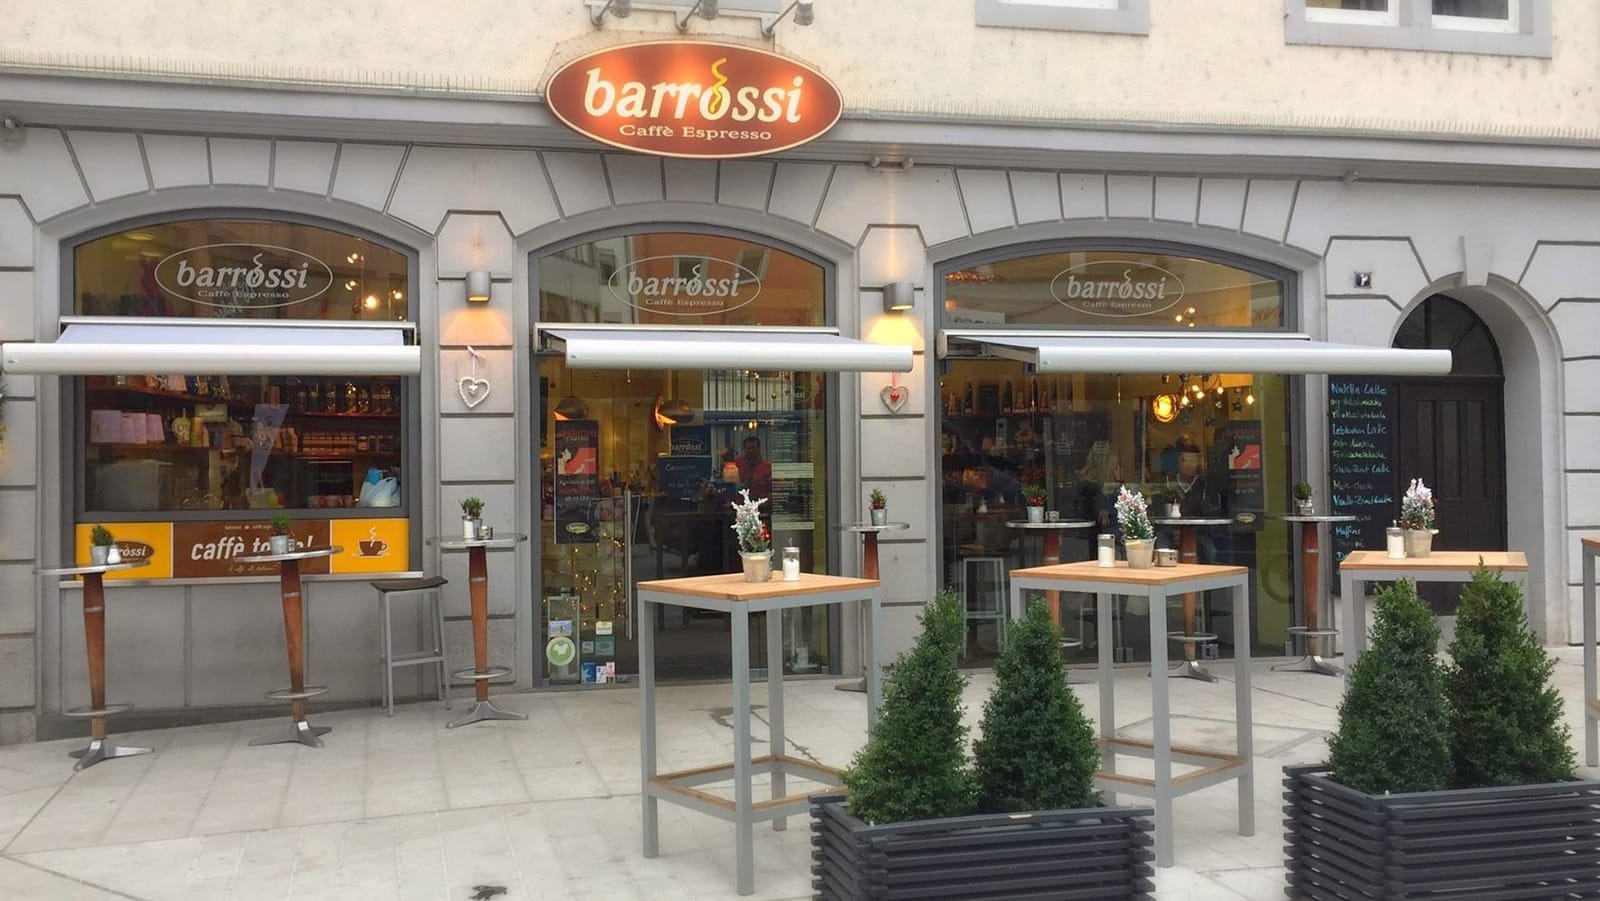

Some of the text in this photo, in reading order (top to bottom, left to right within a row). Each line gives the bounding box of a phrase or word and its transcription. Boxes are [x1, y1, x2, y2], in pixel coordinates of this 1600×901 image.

[584, 66, 804, 124] barrossi
[619, 124, 772, 141] Caffè Espresso
[176, 259, 309, 289] barrossi
[628, 270, 740, 297] barrossi
[234, 290, 290, 299] Espresso
[1066, 275, 1167, 300] barrossi
[677, 299, 724, 307] Espresso
[191, 536, 245, 560] caffè
